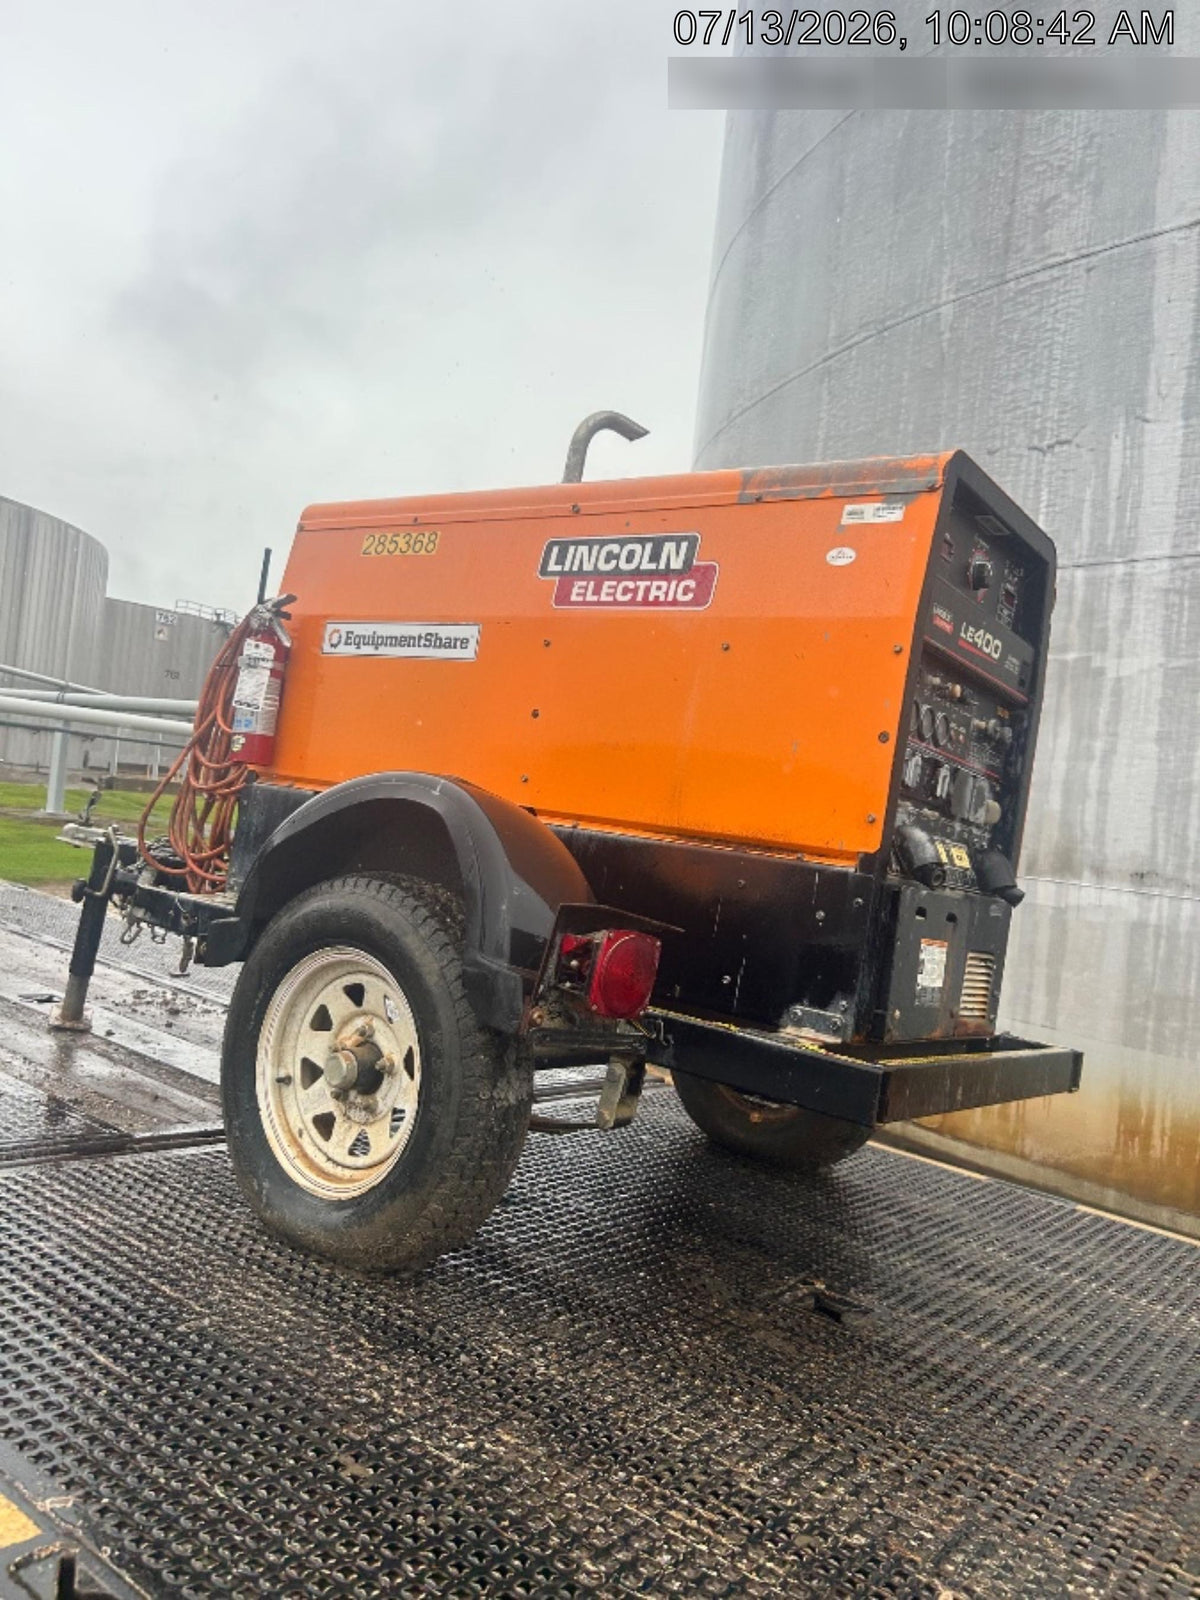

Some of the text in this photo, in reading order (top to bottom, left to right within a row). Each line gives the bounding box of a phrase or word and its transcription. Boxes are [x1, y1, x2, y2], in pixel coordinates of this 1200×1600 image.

[362, 531, 438, 555] 285368
[547, 541, 689, 572] LINCOLN
[570, 579, 696, 602] ELECTRIC
[344, 630, 470, 651] EquipmentShare
[960, 621, 1002, 660] LE400
